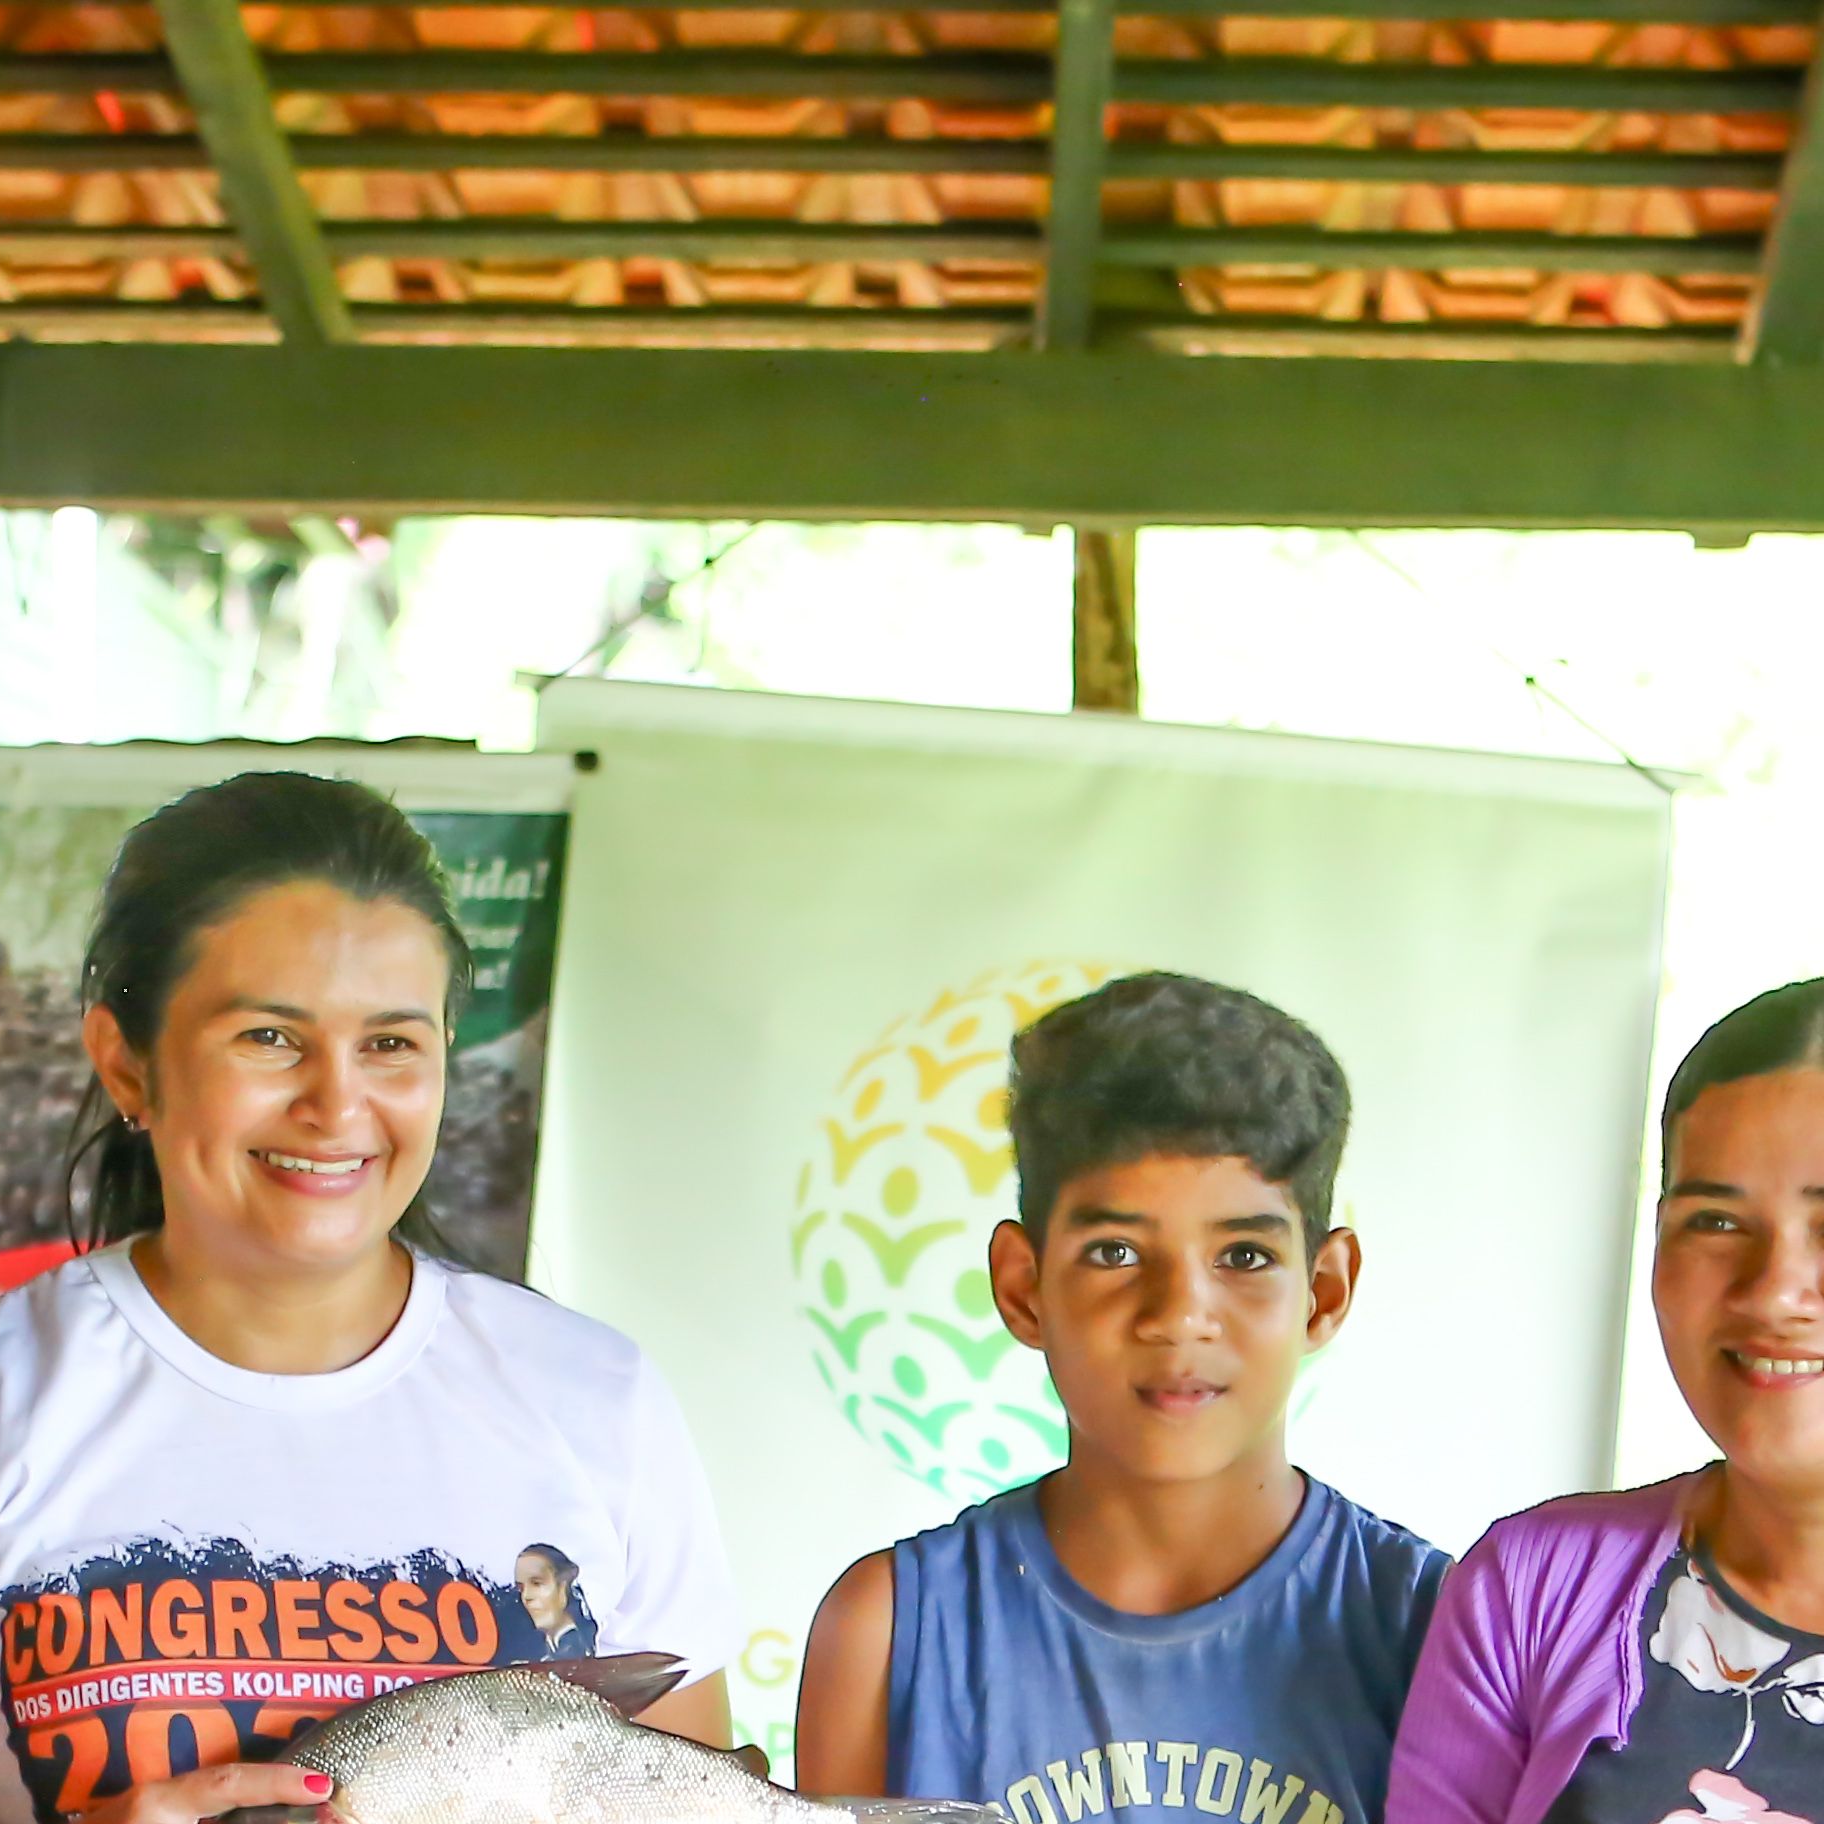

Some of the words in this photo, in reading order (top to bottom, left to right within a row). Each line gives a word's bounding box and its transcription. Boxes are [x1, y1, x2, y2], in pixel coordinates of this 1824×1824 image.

[4, 1578, 499, 1684] CONGRESSO
[14, 1693, 52, 1724] DOS
[57, 1672, 225, 1715] DIRIGENTES
[233, 1672, 364, 1699] KOLPING
